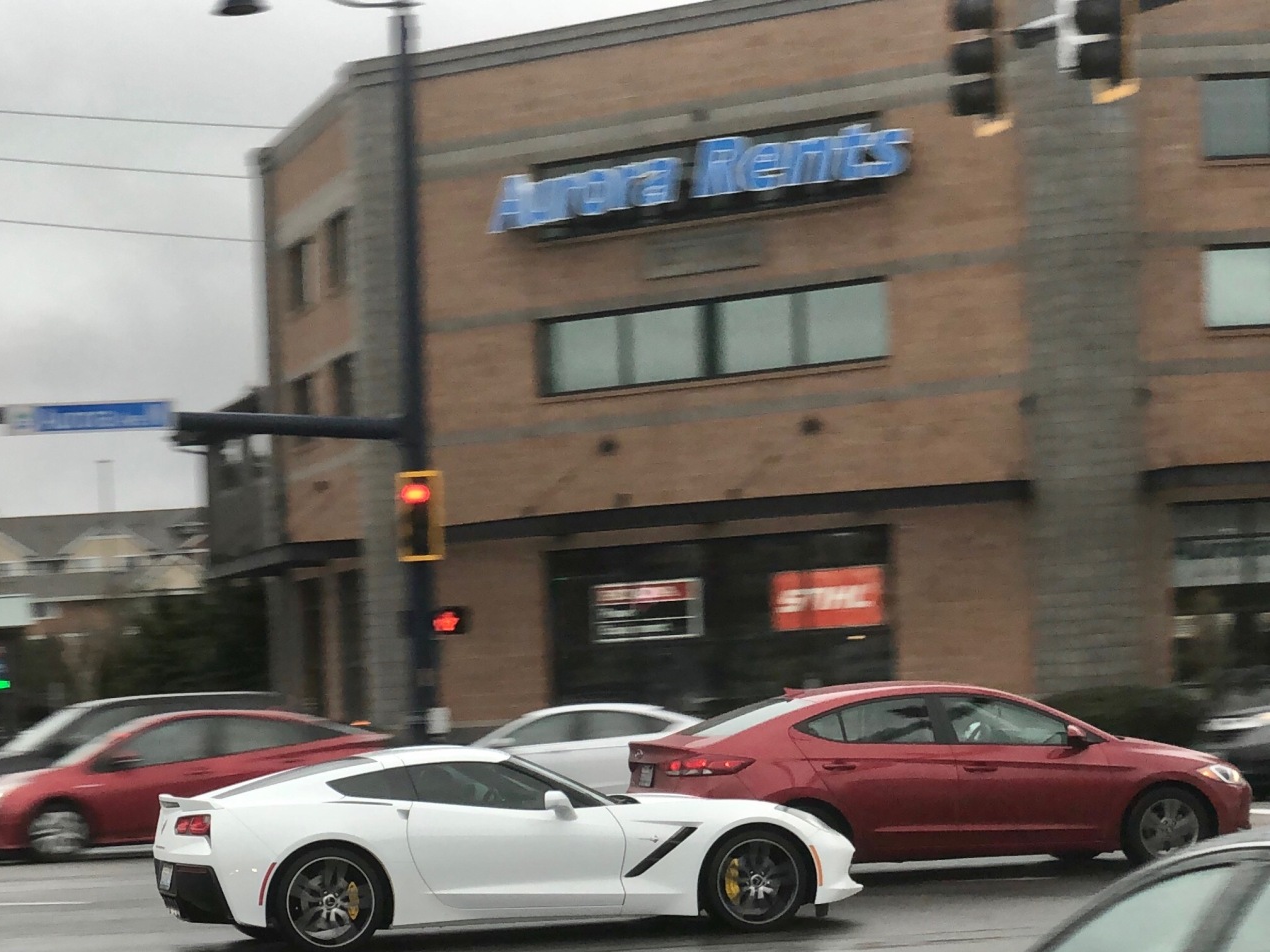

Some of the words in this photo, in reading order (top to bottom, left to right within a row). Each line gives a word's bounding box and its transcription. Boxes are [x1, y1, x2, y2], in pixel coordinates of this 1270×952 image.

[486, 157, 683, 234] Aurora
[690, 123, 914, 198] Rents
[776, 582, 877, 613] STIHL
